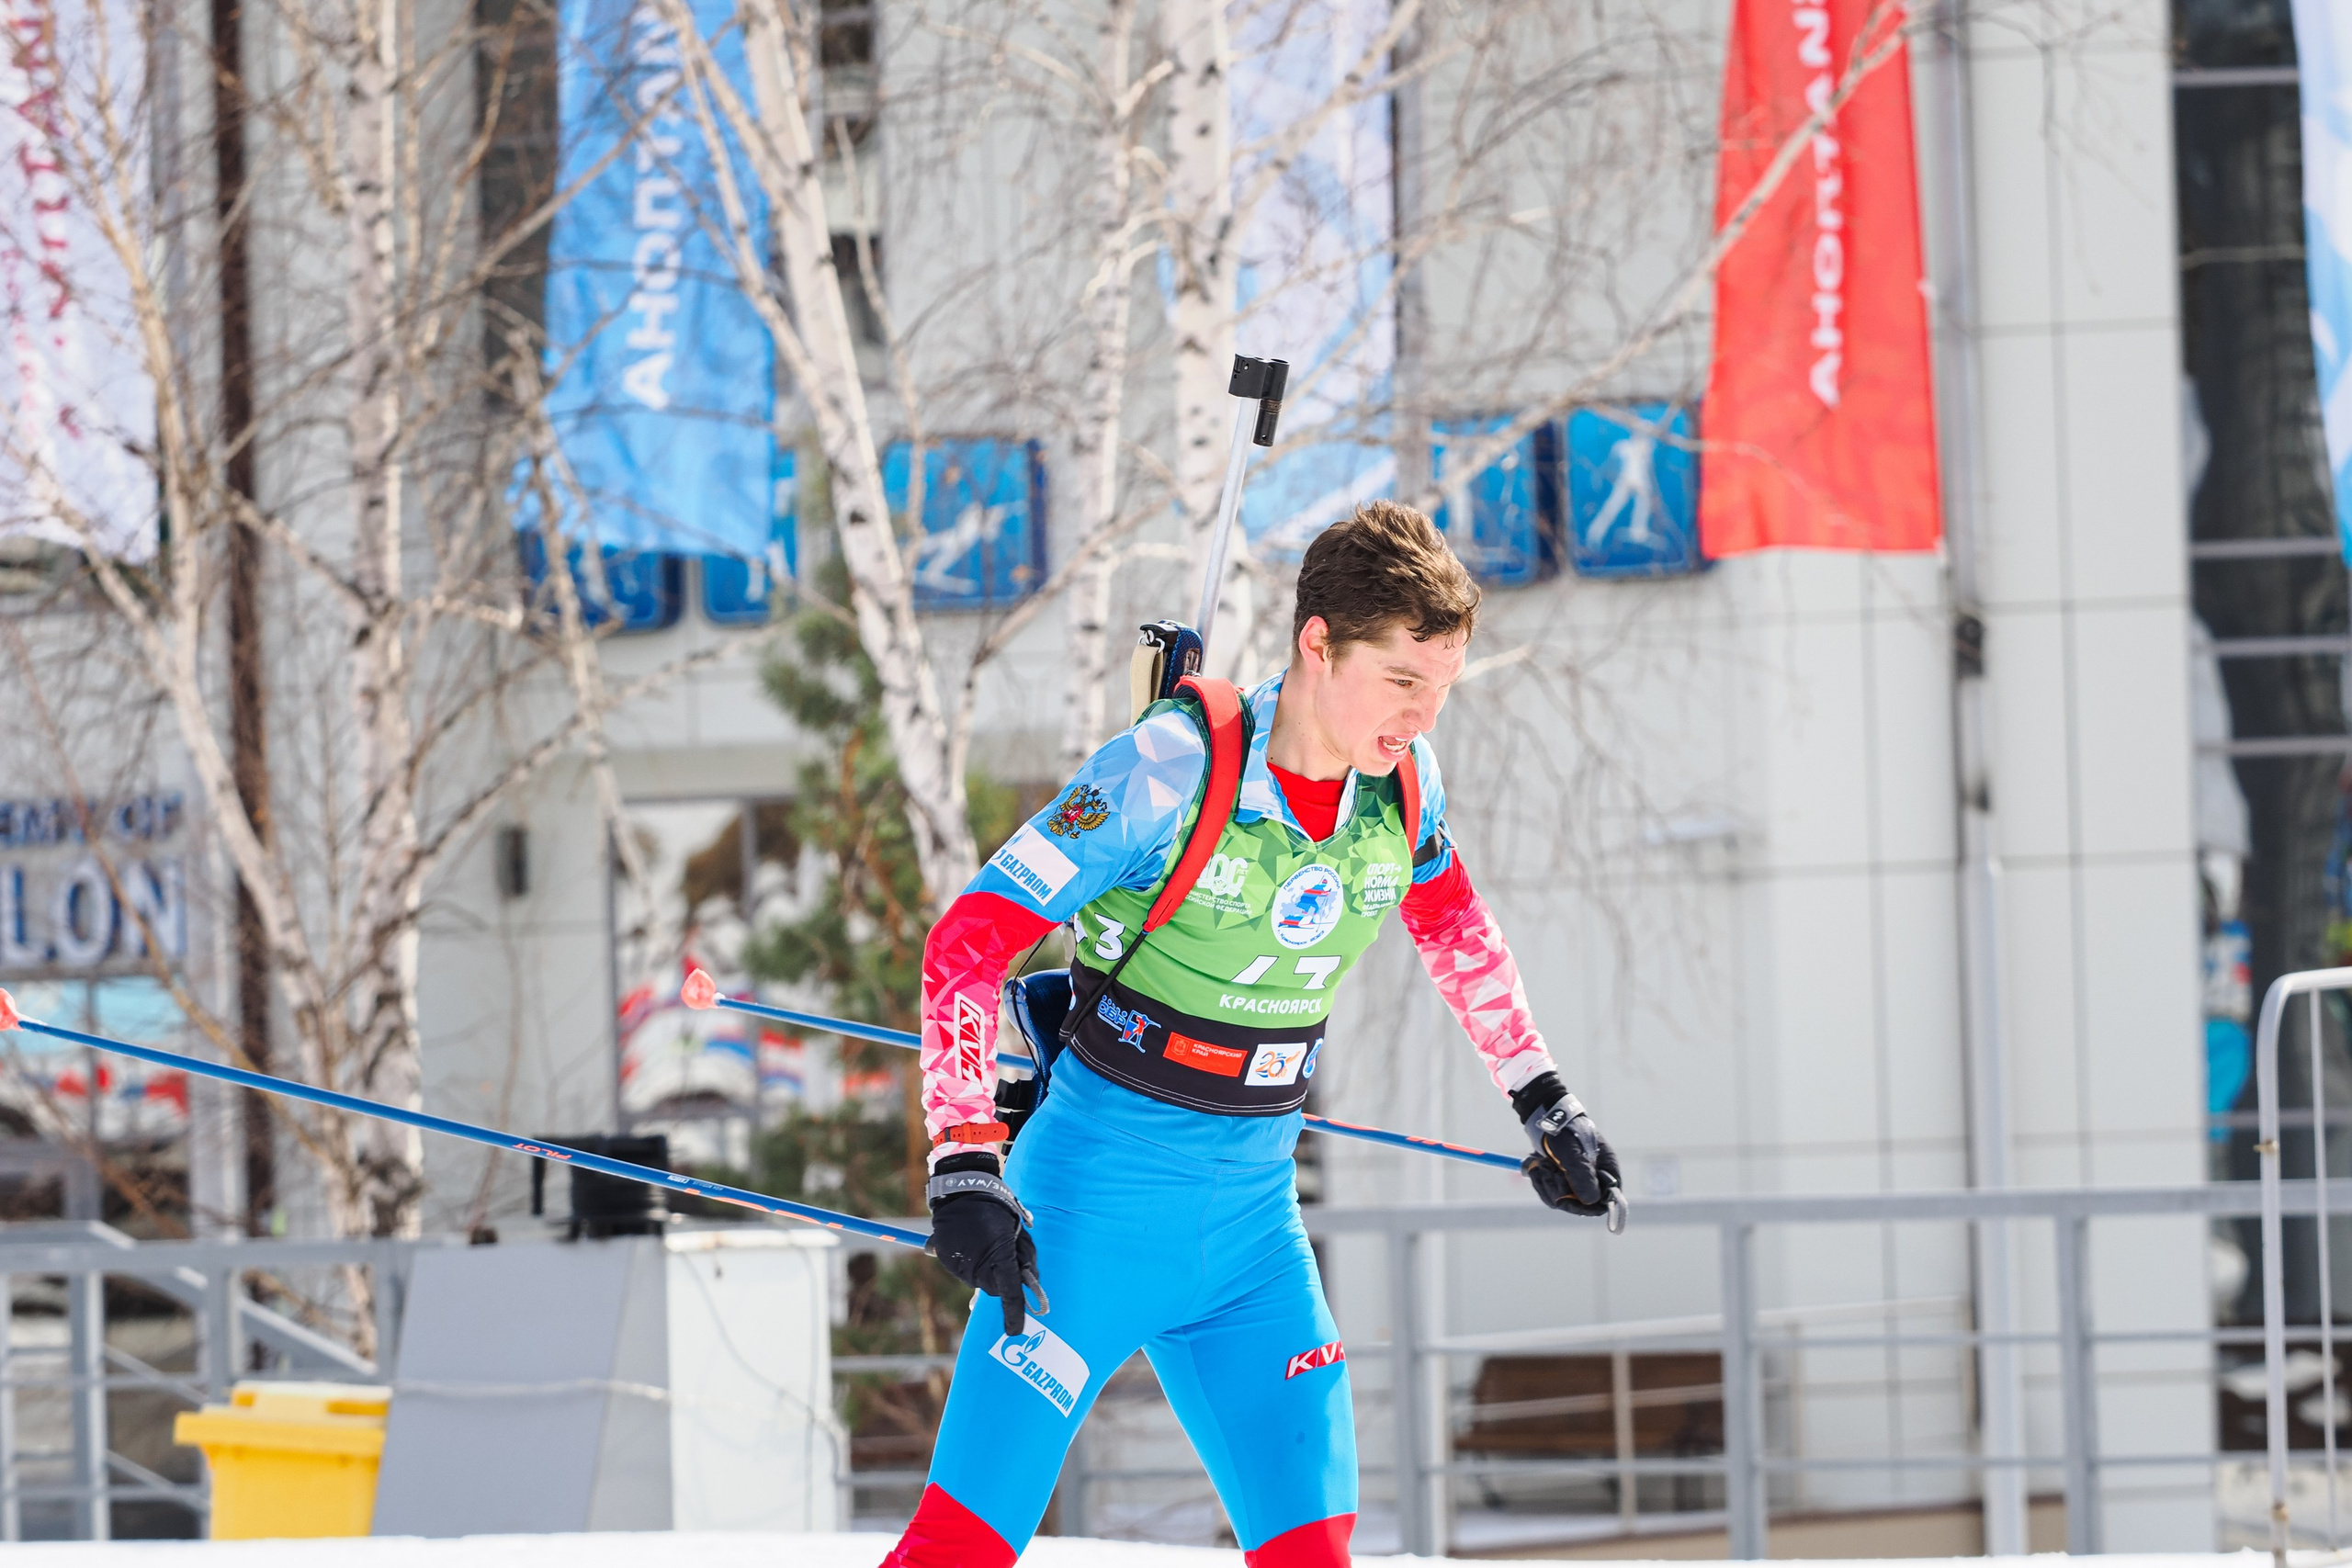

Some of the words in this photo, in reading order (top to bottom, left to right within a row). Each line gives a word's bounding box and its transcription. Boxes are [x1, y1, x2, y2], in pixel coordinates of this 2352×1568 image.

[1000, 852, 1053, 900] GAZPROM
[1366, 863, 1396, 875] СПОРТ
[1283, 866, 1324, 891] ПЕРВЕНСТВО
[1324, 867, 1341, 890] РОССИИ
[1364, 875, 1399, 889] НОРМА
[1363, 887, 1396, 903] ЖИЗНИ
[1229, 900, 1251, 908] СПОРТА
[1218, 993, 1323, 1014] КРАСНОЯРСК
[1191, 1048, 1209, 1057] КРАЙ
[1193, 1043, 1243, 1058] КРАСНОЯРСКИЙ
[512, 1143, 572, 1161] PILOT
[1021, 1360, 1075, 1412] GAZPROM
